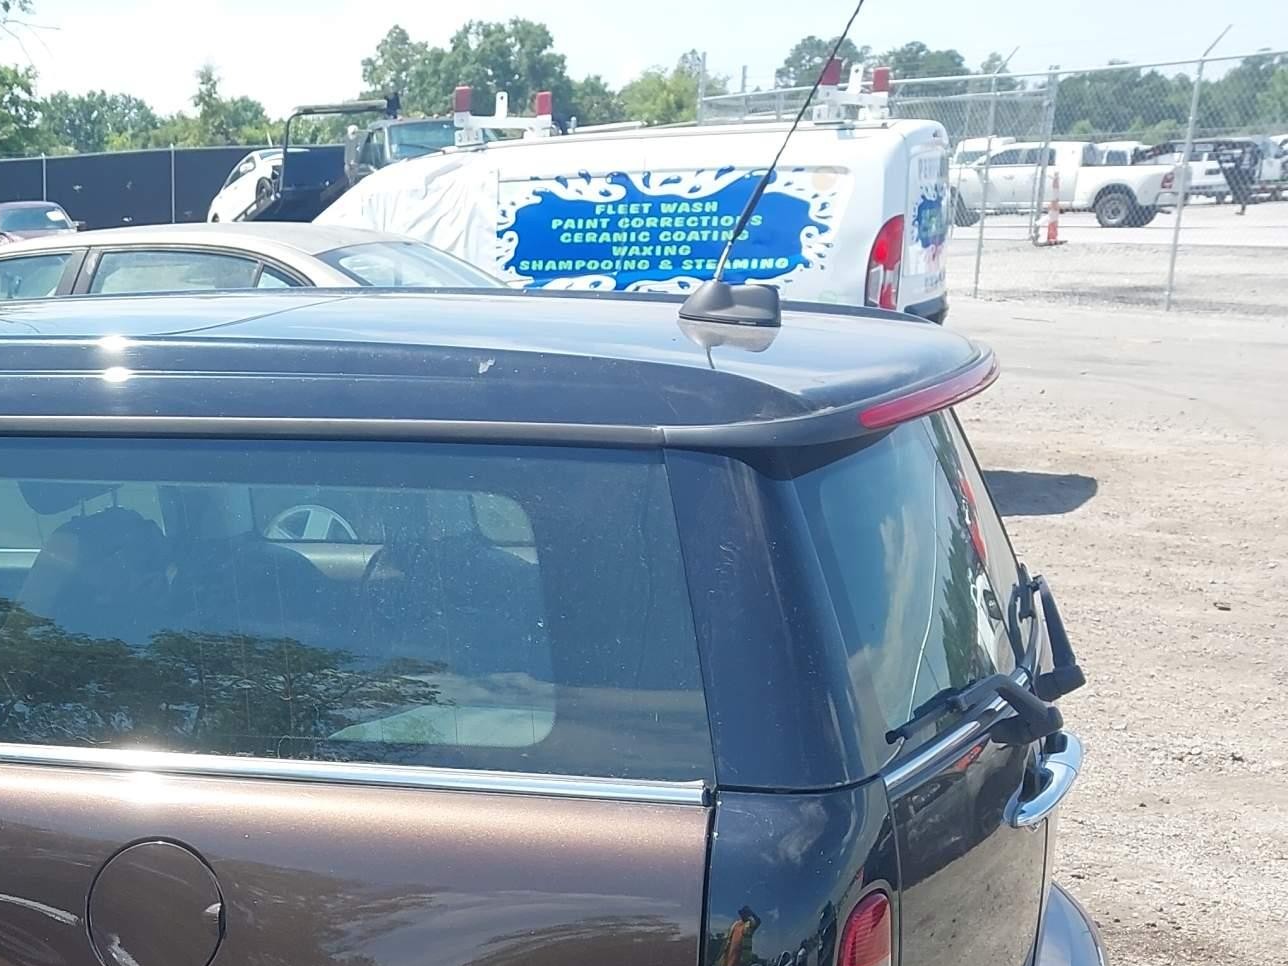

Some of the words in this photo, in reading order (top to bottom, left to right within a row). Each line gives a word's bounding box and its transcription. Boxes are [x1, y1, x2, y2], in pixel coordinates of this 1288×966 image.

[595, 203, 652, 215] FLEET
[660, 201, 718, 214] WASH
[551, 218, 610, 230] PAINT
[559, 230, 651, 243] CERAMIC
[658, 229, 749, 242] COATING
[612, 244, 691, 257] WAXING
[519, 259, 650, 271] SHAMPOOING
[658, 259, 673, 270] &
[681, 257, 789, 270] STEAMING
